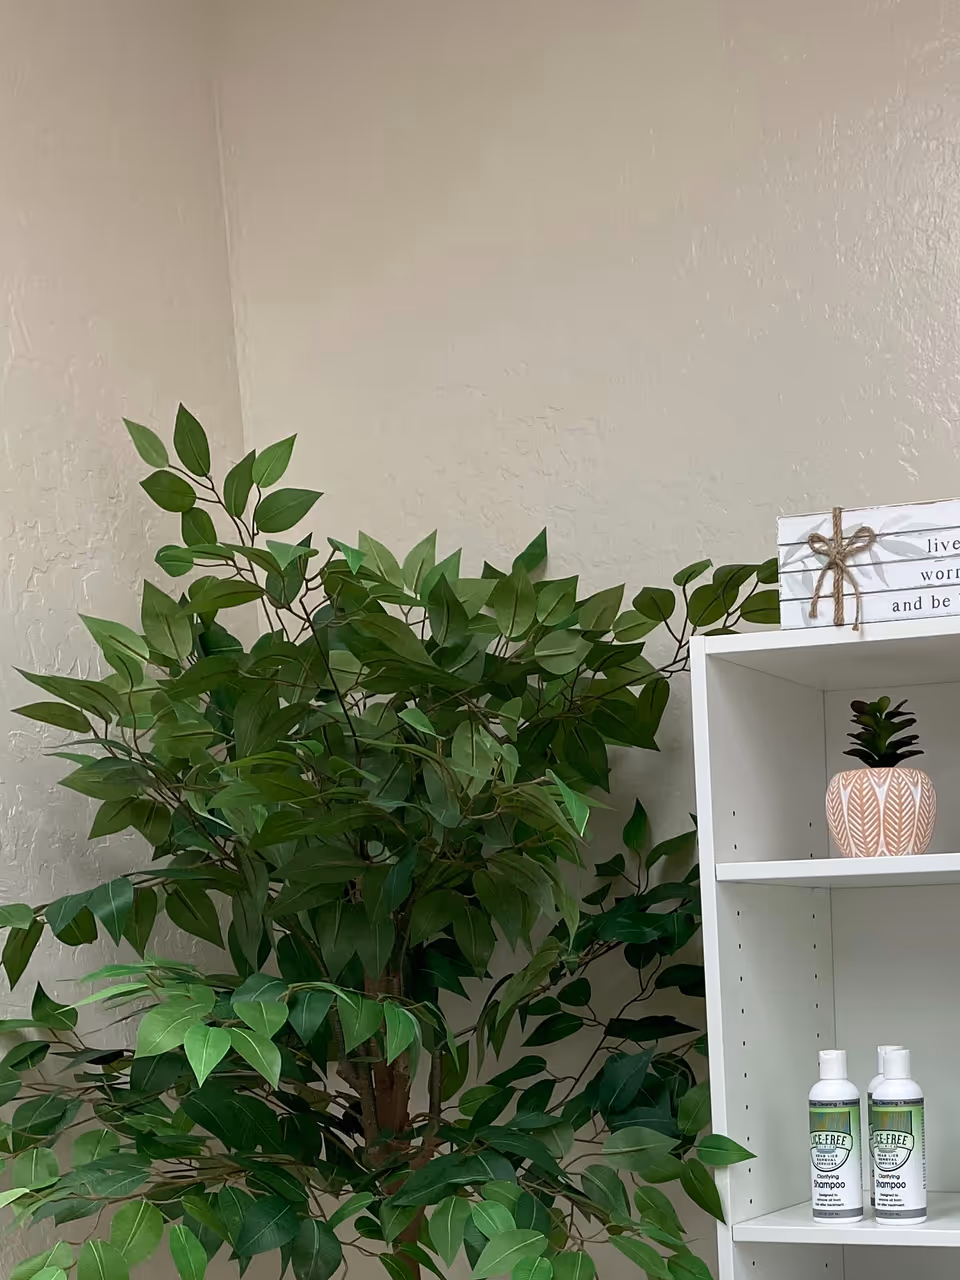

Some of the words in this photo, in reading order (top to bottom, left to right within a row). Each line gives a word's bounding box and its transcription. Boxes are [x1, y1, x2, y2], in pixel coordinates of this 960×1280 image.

[927, 538, 960, 553] live
[892, 596, 922, 612] and
[931, 595, 951, 609] be
[814, 1180, 845, 1190] Shampoo
[876, 1179, 906, 1190] Shampoo
